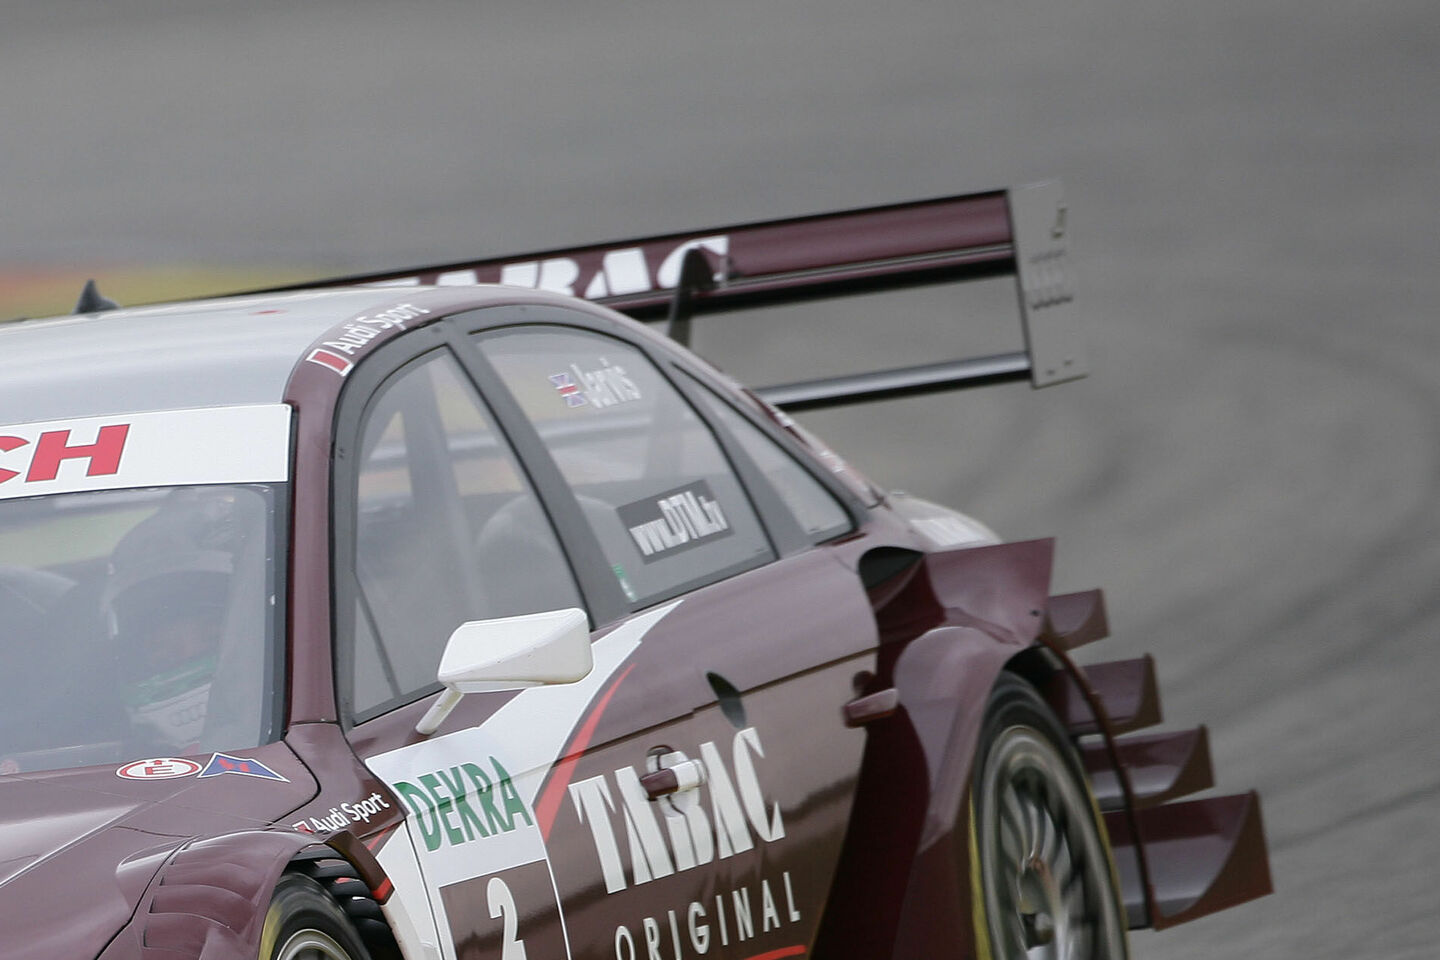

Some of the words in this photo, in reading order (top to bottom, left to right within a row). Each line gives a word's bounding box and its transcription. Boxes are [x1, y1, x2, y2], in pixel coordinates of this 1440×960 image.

[309, 805, 349, 833] Audi
[343, 791, 391, 823] Sport
[392, 755, 535, 852] DEKRA
